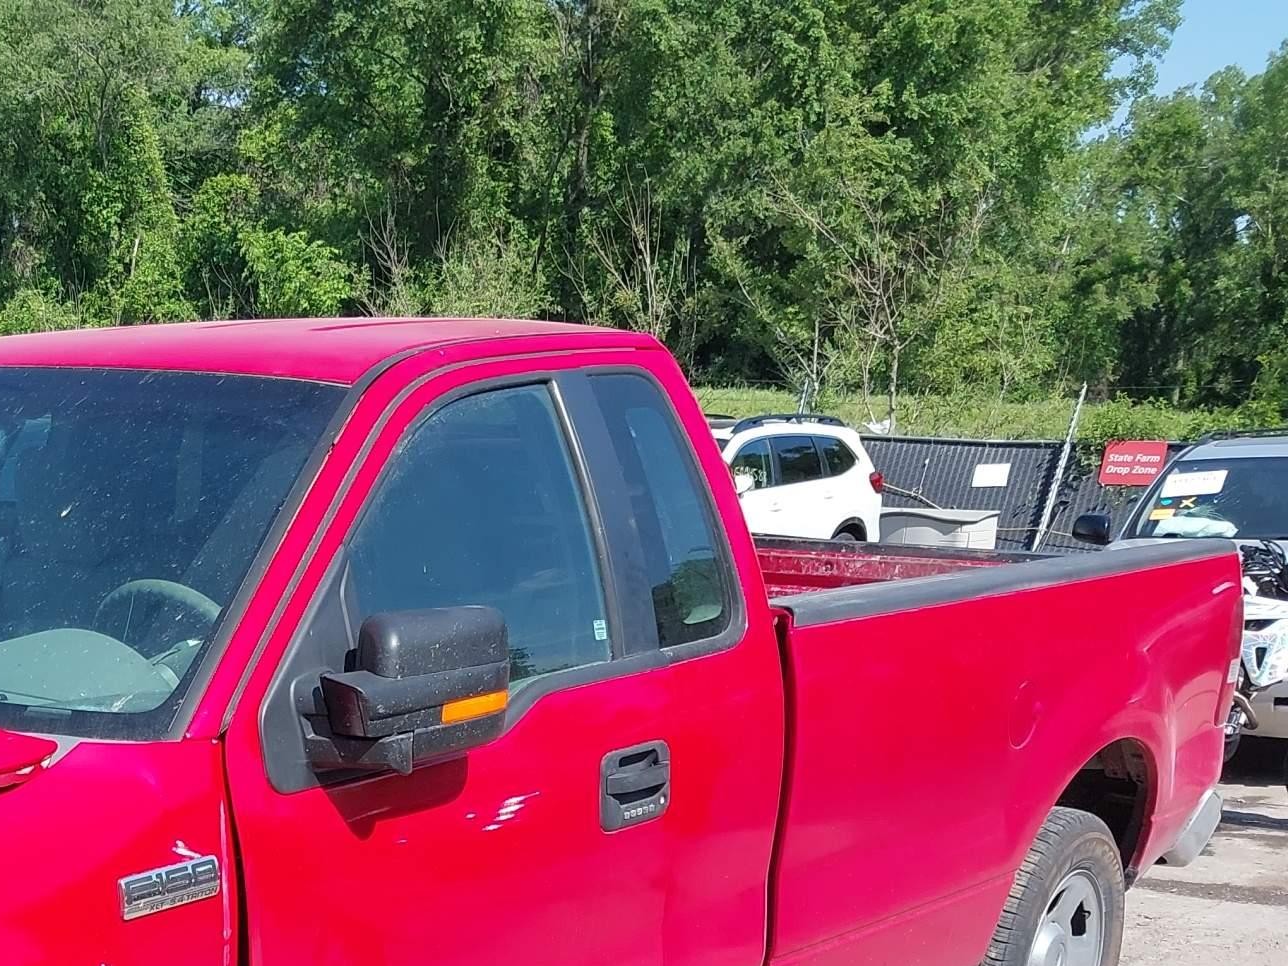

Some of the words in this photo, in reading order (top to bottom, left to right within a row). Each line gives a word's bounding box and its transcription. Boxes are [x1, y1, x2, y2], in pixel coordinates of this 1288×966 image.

[1108, 453, 1133, 463] State
[1135, 454, 1160, 463] Farm
[1106, 465, 1130, 475] Drop
[1132, 466, 1157, 475] Zone
